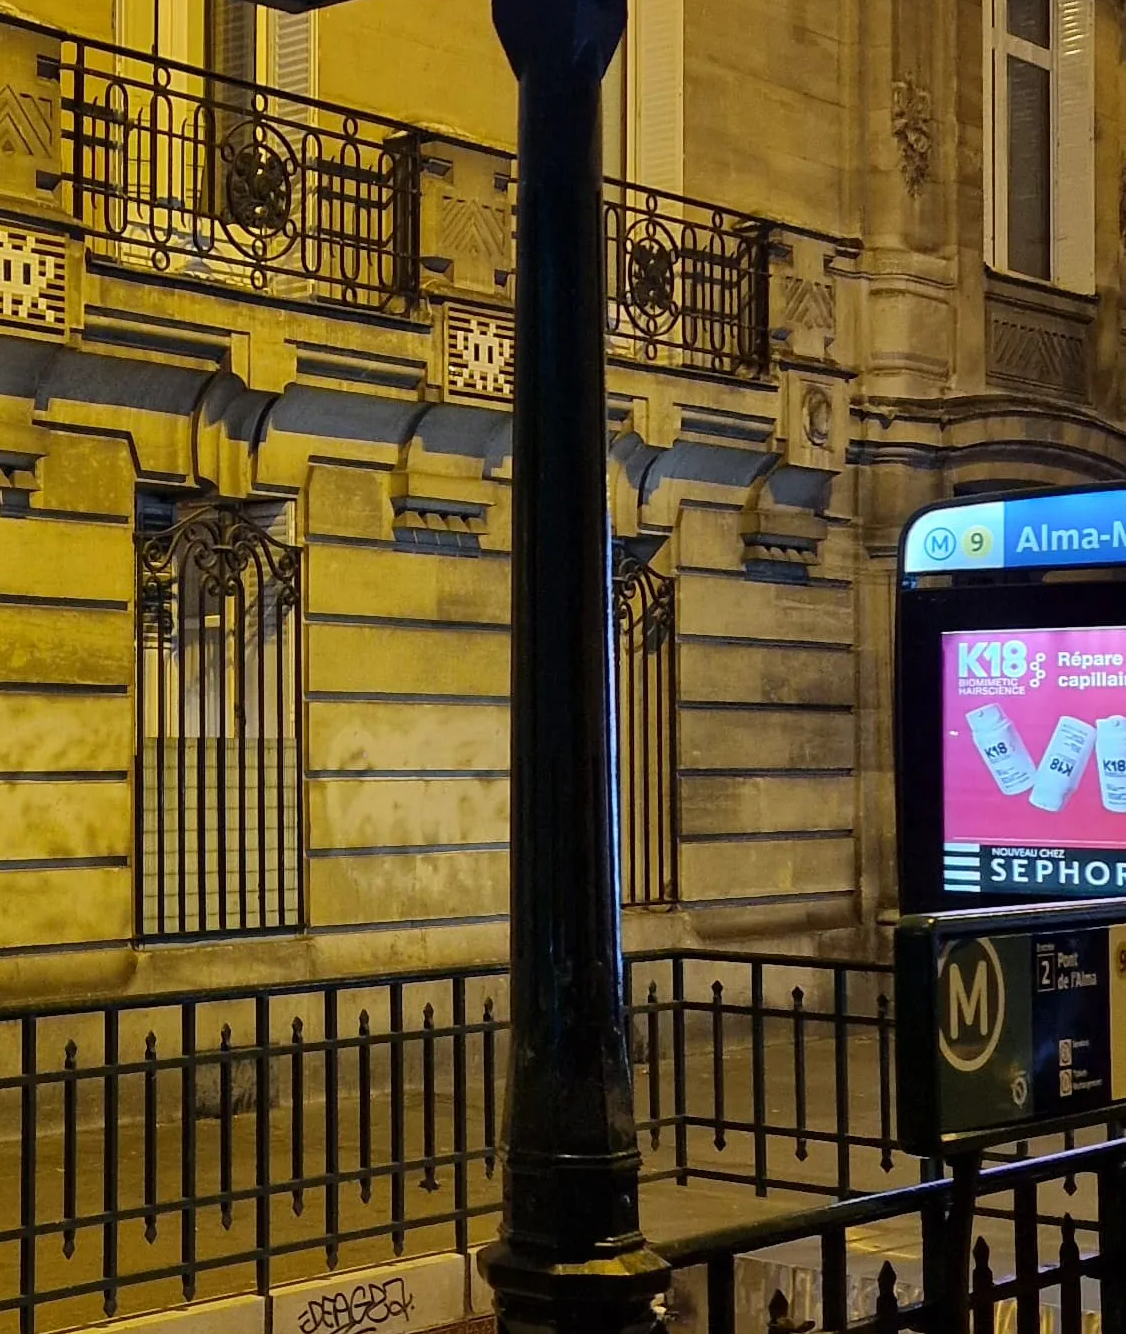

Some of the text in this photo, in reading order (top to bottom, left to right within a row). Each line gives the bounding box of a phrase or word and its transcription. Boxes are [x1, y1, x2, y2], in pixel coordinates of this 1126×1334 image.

[970, 532, 984, 552] 9
[957, 639, 1028, 678] K18
[1058, 651, 1124, 669] Répare
[958, 677, 1019, 687] BIOMIMETIC
[1058, 671, 1126, 690] capillai
[984, 741, 1008, 759] K18
[1050, 758, 1074, 777] K18
[1103, 758, 1126, 772] K18
[991, 848, 1065, 858] NOUVEAU CHEZ
[1041, 960, 1051, 985] 2
[1057, 973, 1069, 989] de
